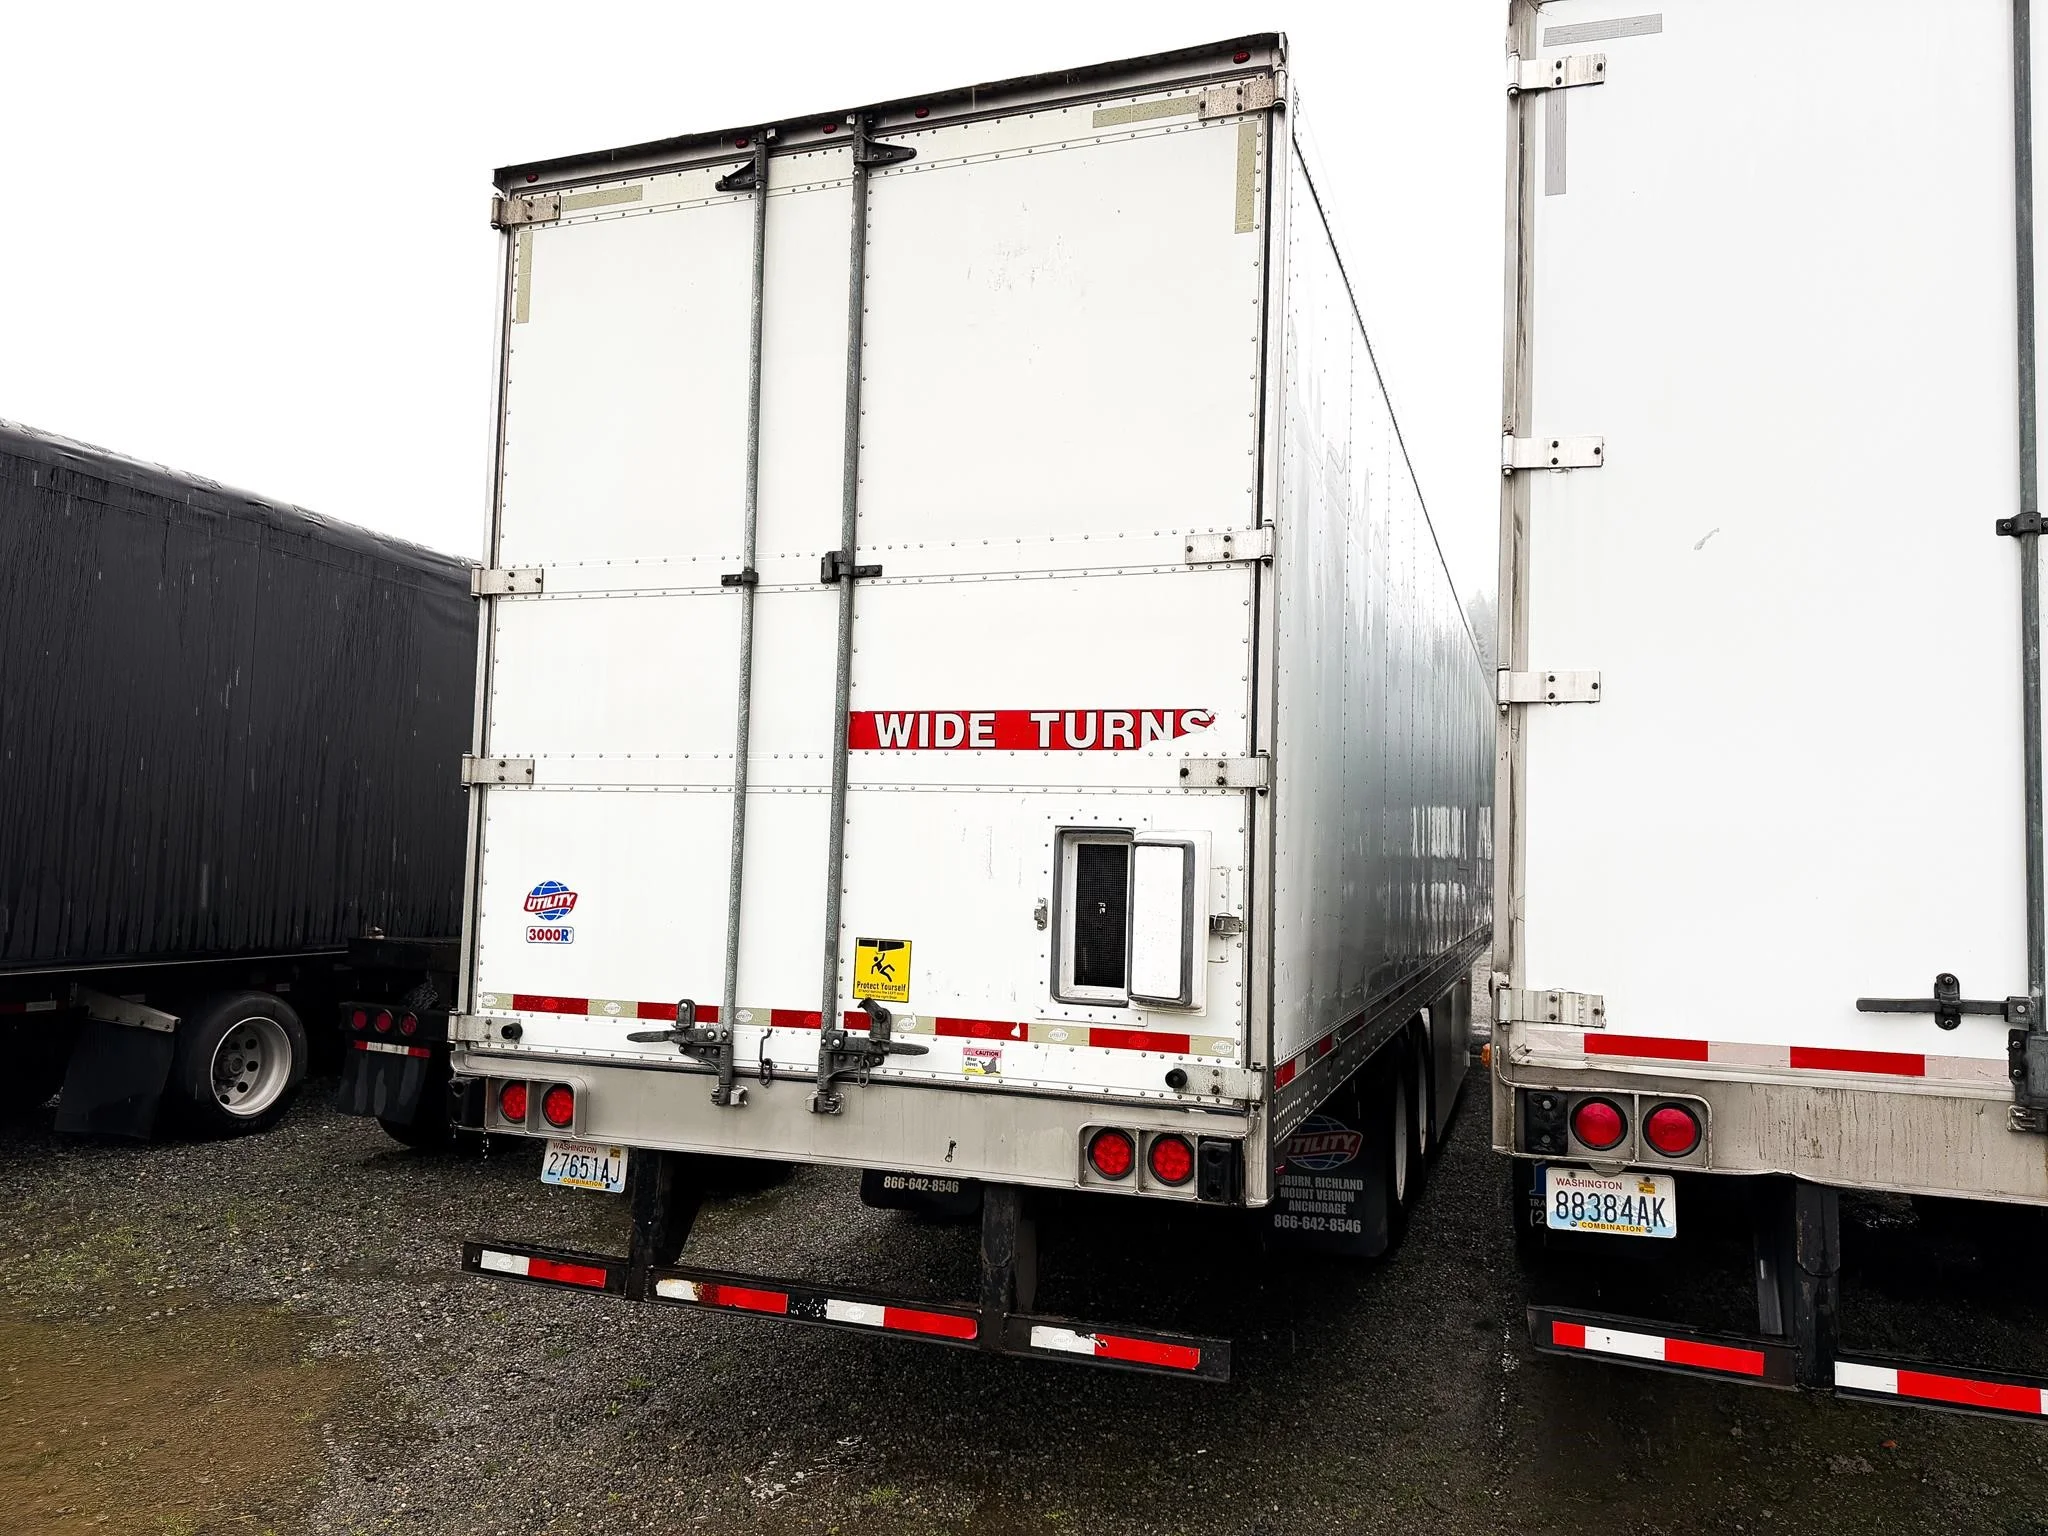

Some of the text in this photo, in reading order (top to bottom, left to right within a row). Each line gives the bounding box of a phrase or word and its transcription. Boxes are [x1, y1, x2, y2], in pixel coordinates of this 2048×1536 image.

[873, 712, 997, 749] WIDE
[526, 893, 576, 911] UTILITY
[528, 928, 570, 942] 3000R
[857, 980, 880, 990] Protect
[881, 982, 906, 993] Yourself
[553, 1142, 598, 1154] WASHINGTON
[547, 1151, 621, 1184] 27651AJ
[563, 1177, 602, 1187] COMBINATION
[883, 1175, 960, 1193] 866-642-8546
[1315, 1176, 1364, 1191] RICHLAND
[1555, 1177, 1623, 1190] WASHINGTON
[1280, 1187, 1355, 1203] MOUNT VERNON
[1288, 1200, 1347, 1214] ANCHORAGE
[1555, 1190, 1667, 1228] 88384AK
[1274, 1214, 1362, 1233] 866-642-8546
[1581, 1221, 1642, 1233] COMBINATION
